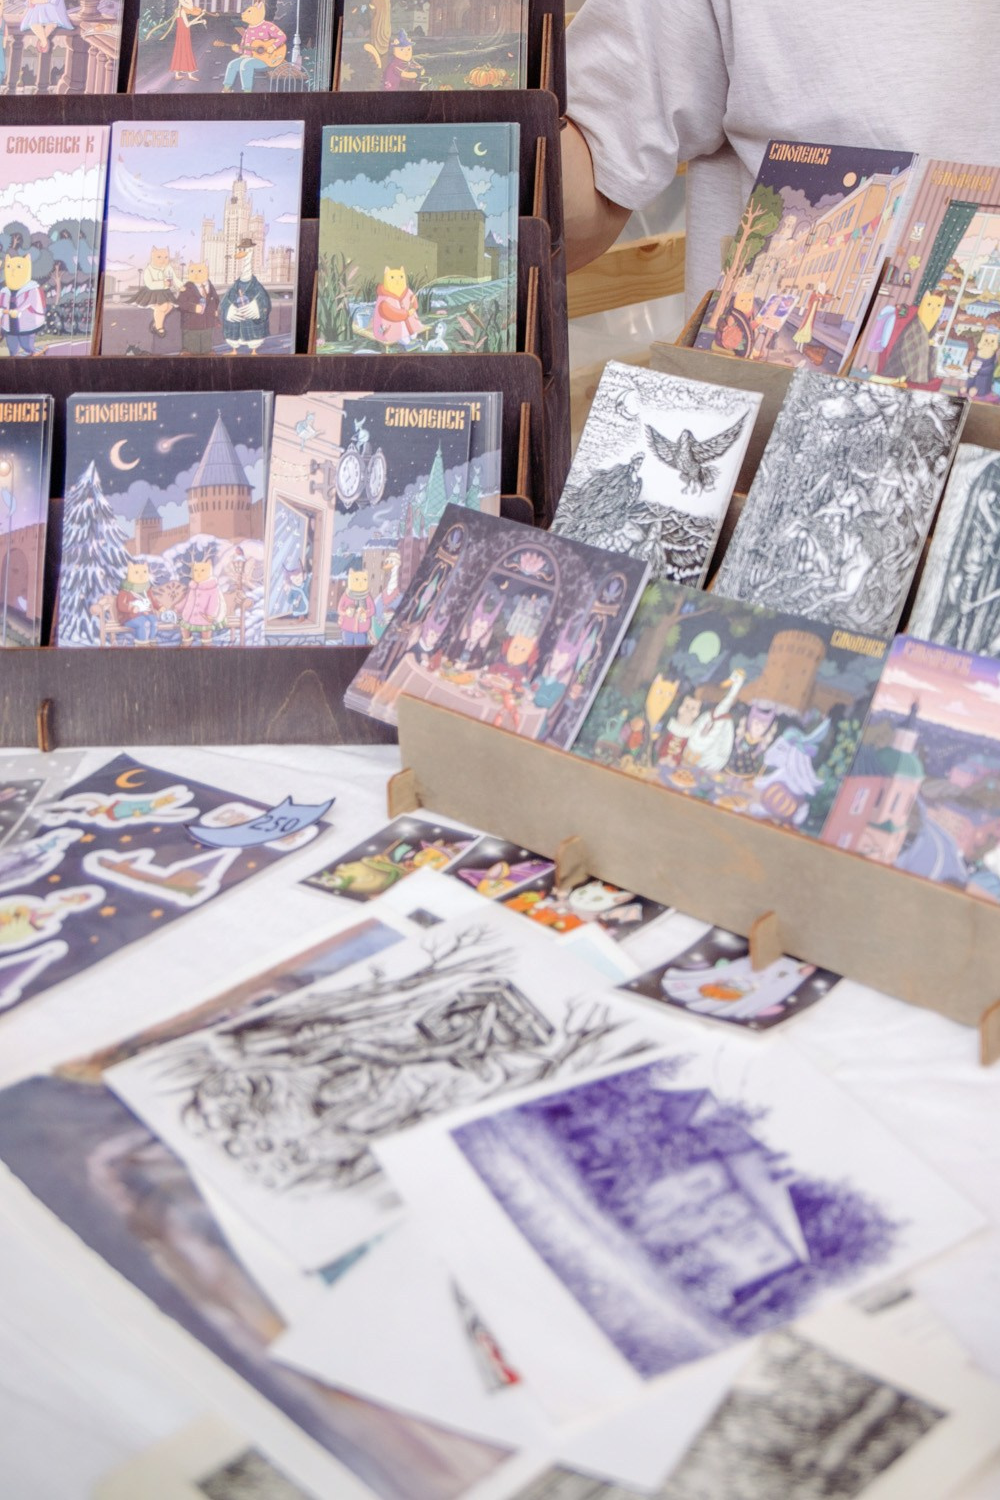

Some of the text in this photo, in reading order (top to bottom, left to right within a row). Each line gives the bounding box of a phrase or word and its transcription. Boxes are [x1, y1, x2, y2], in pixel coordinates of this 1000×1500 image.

[6, 136, 80, 154] СМОЛЕНСК
[120, 130, 179, 148] МОСКВА
[330, 134, 407, 153] СМОЛЕНСК
[769, 143, 832, 165] СМОЛЕНСК
[75, 402, 157, 424] СМОЛЕНСК
[385, 407, 465, 430] СМОЛЕНСК
[248, 815, 300, 832] 250
